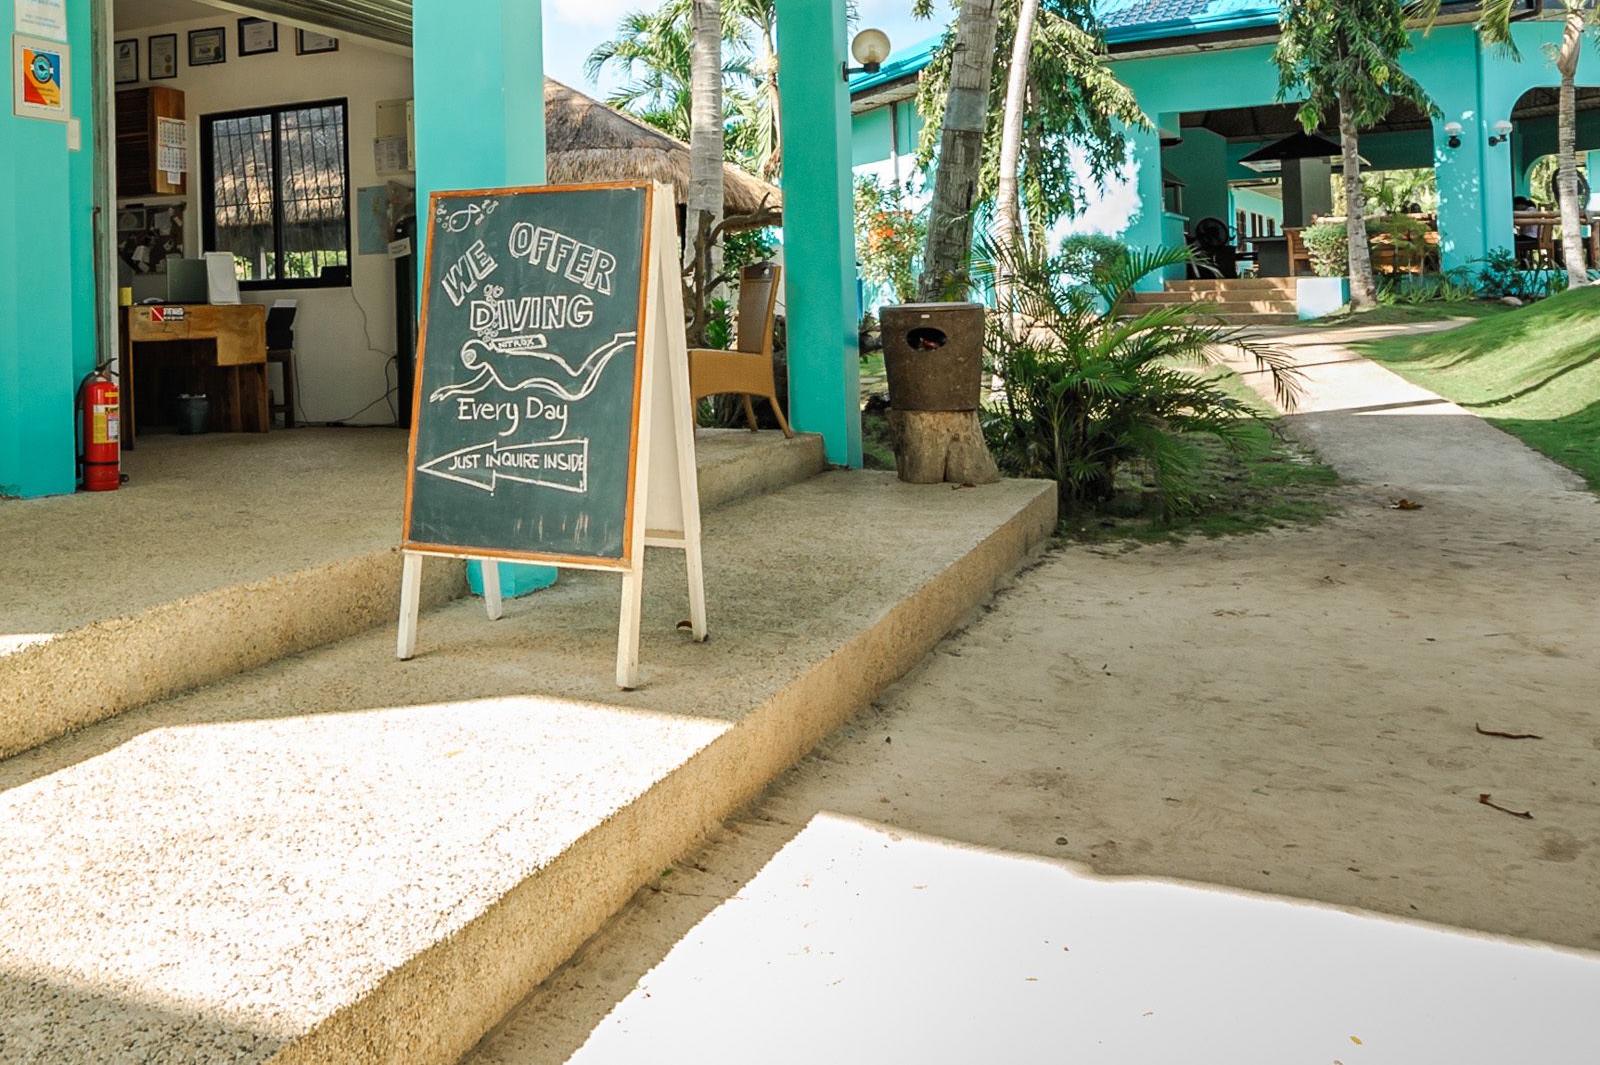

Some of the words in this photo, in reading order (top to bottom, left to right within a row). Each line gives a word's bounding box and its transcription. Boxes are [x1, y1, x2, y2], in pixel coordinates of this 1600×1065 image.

[441, 239, 498, 307] WE
[508, 221, 617, 296] OFFER
[469, 293, 595, 333] DIVING
[497, 338, 535, 349] NITROX
[457, 397, 520, 436] Every
[526, 397, 569, 440] Day
[448, 453, 482, 471] JUST
[485, 452, 540, 469] INQUIRE
[543, 453, 585, 472] INSIDE
